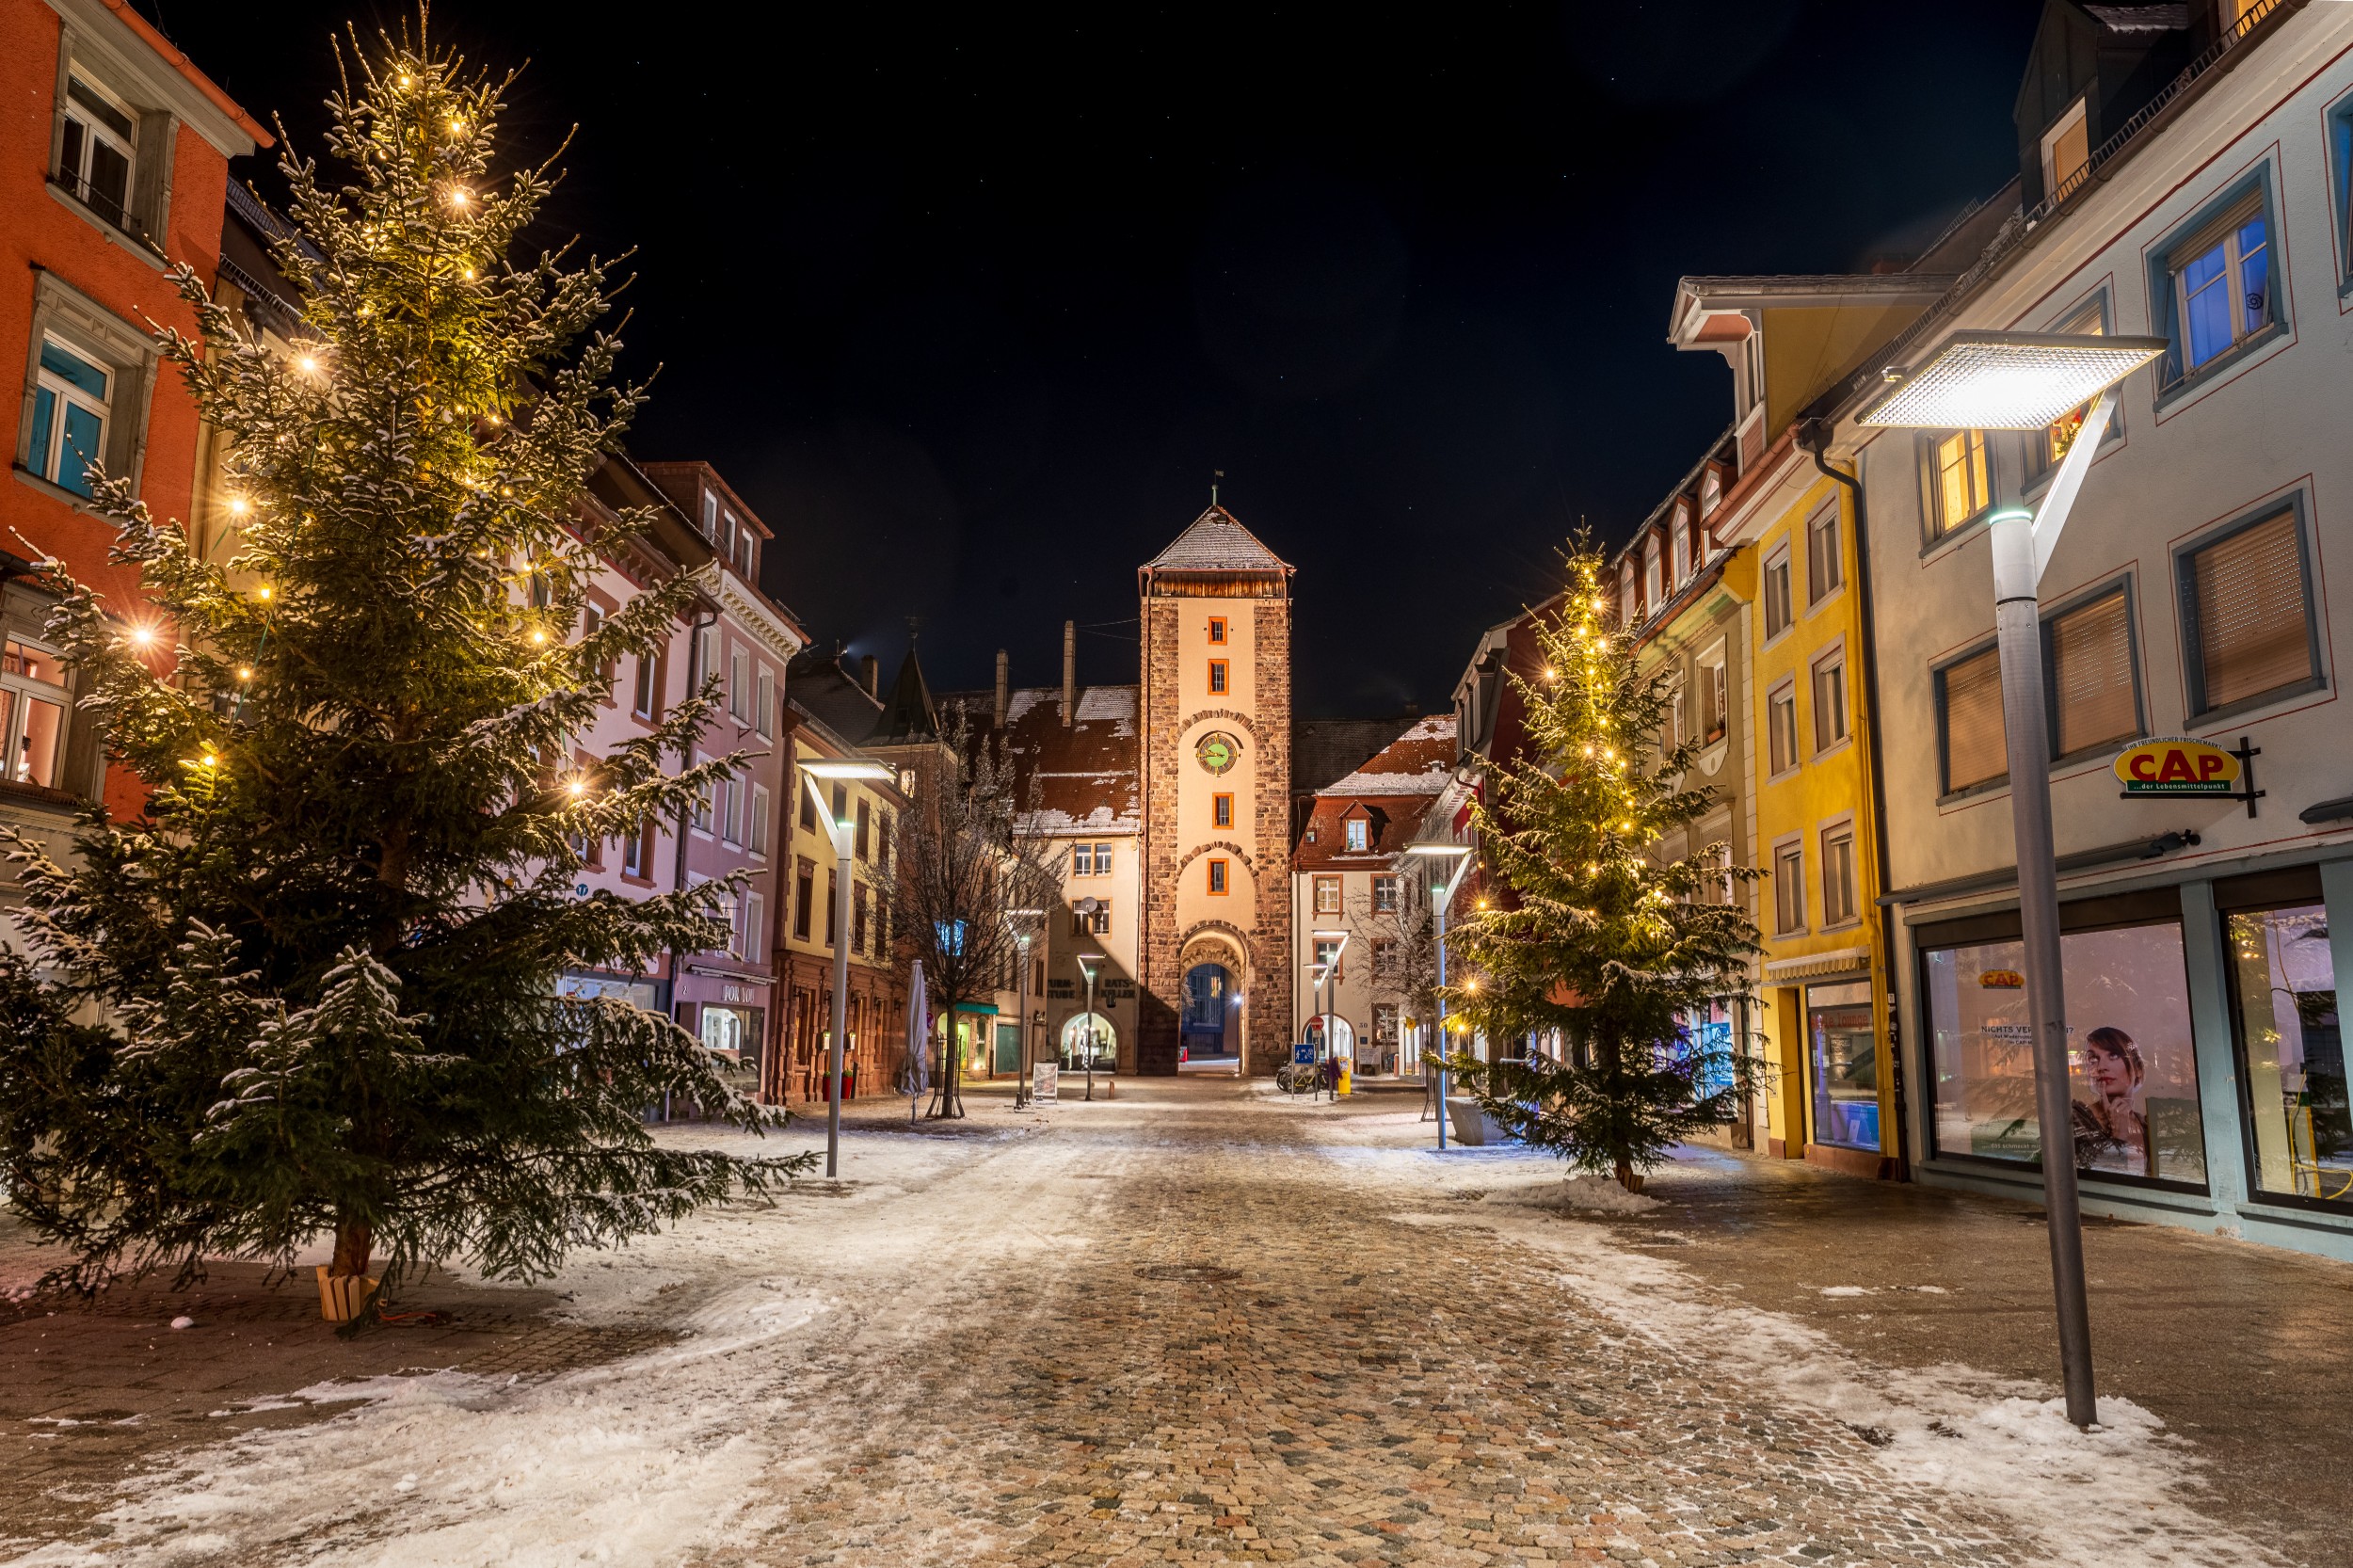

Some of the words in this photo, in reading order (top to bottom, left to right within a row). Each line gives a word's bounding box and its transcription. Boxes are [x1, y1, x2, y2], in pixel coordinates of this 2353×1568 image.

[2138, 736, 2179, 746] FREUNDLICHER
[2180, 737, 2222, 750] FRISCHEMARKT
[2129, 749, 2224, 783] CAP
[1983, 973, 2019, 986] CAP
[682, 985, 688, 996] 2
[723, 985, 740, 1001] FOR
[742, 986, 755, 1003] YOU
[1836, 1012, 1869, 1031] lounge
